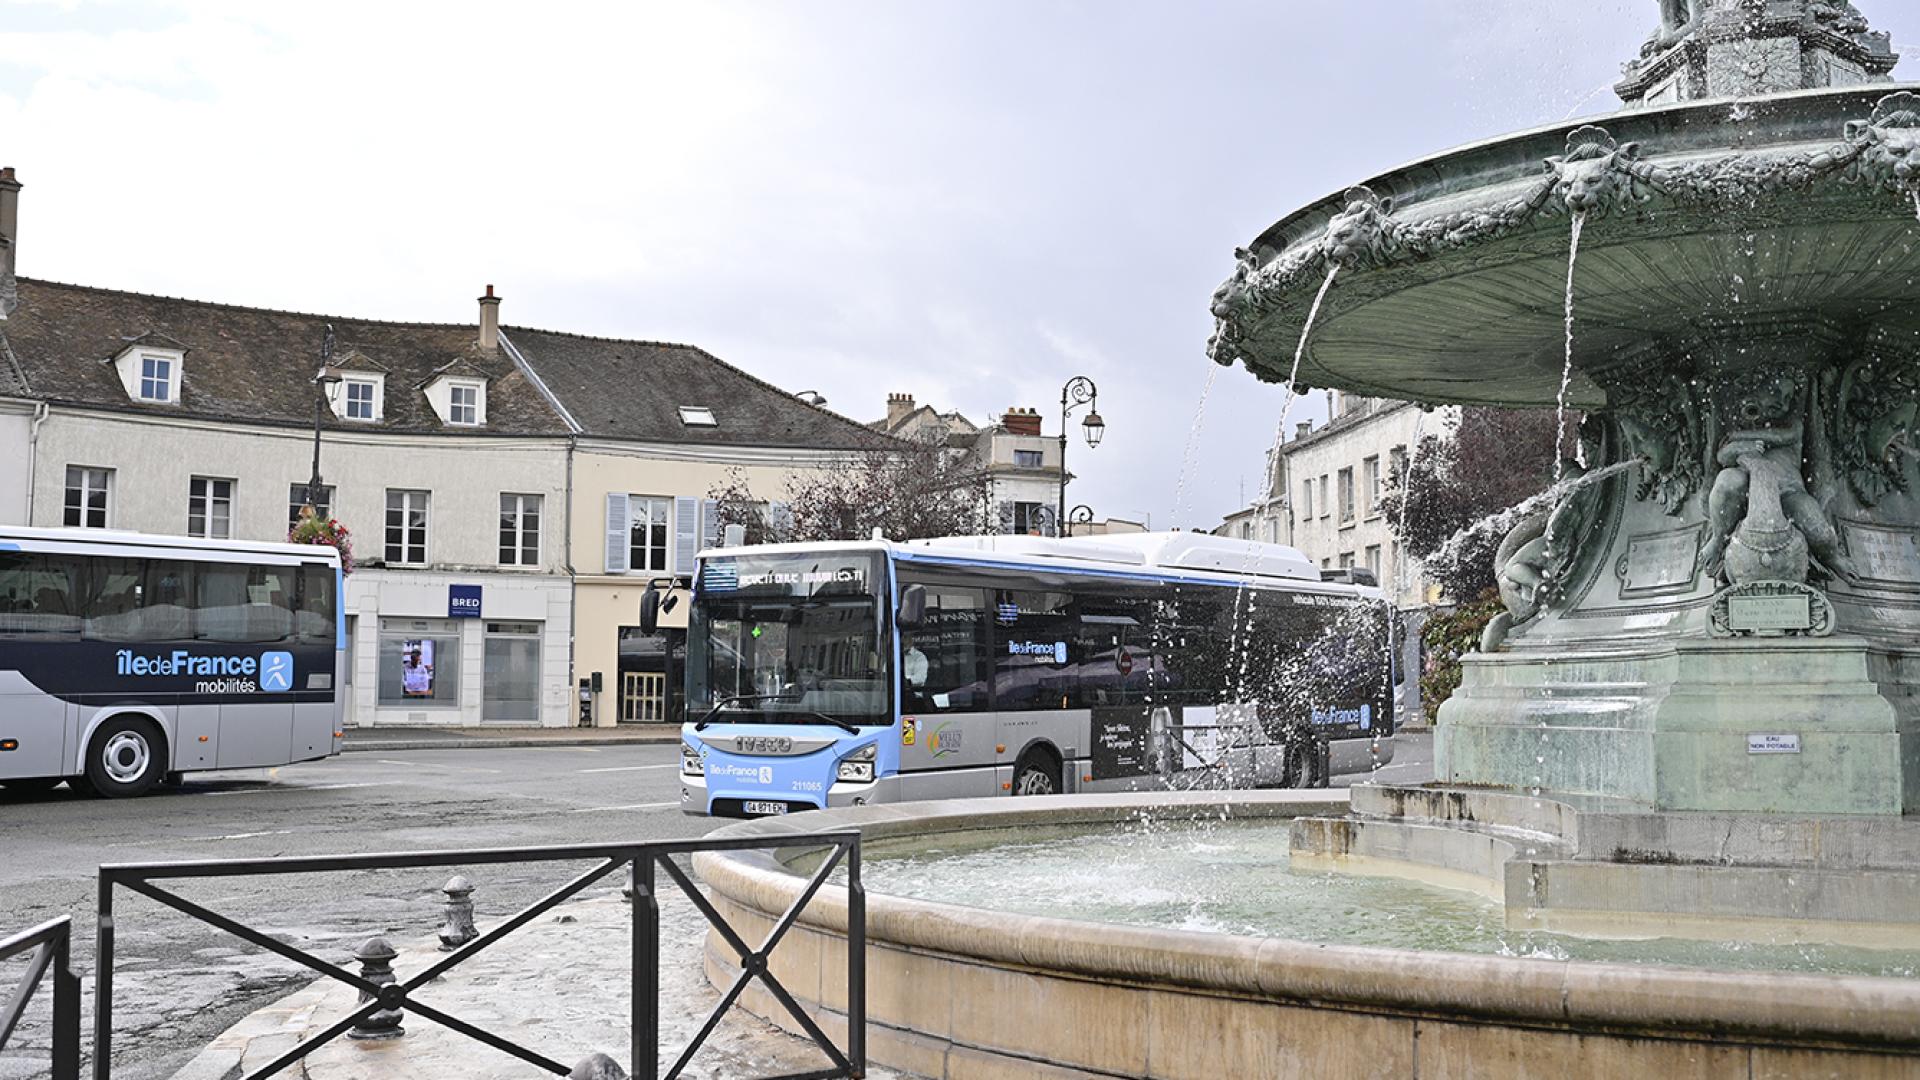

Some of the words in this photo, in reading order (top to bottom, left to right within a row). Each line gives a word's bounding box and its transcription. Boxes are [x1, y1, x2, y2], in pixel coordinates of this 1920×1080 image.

[452, 598, 480, 607] BRED
[116, 649, 256, 676] îledeFrance
[195, 677, 256, 693] mobilités
[736, 736, 793, 753] IVECO
[792, 781, 822, 792] 211065
